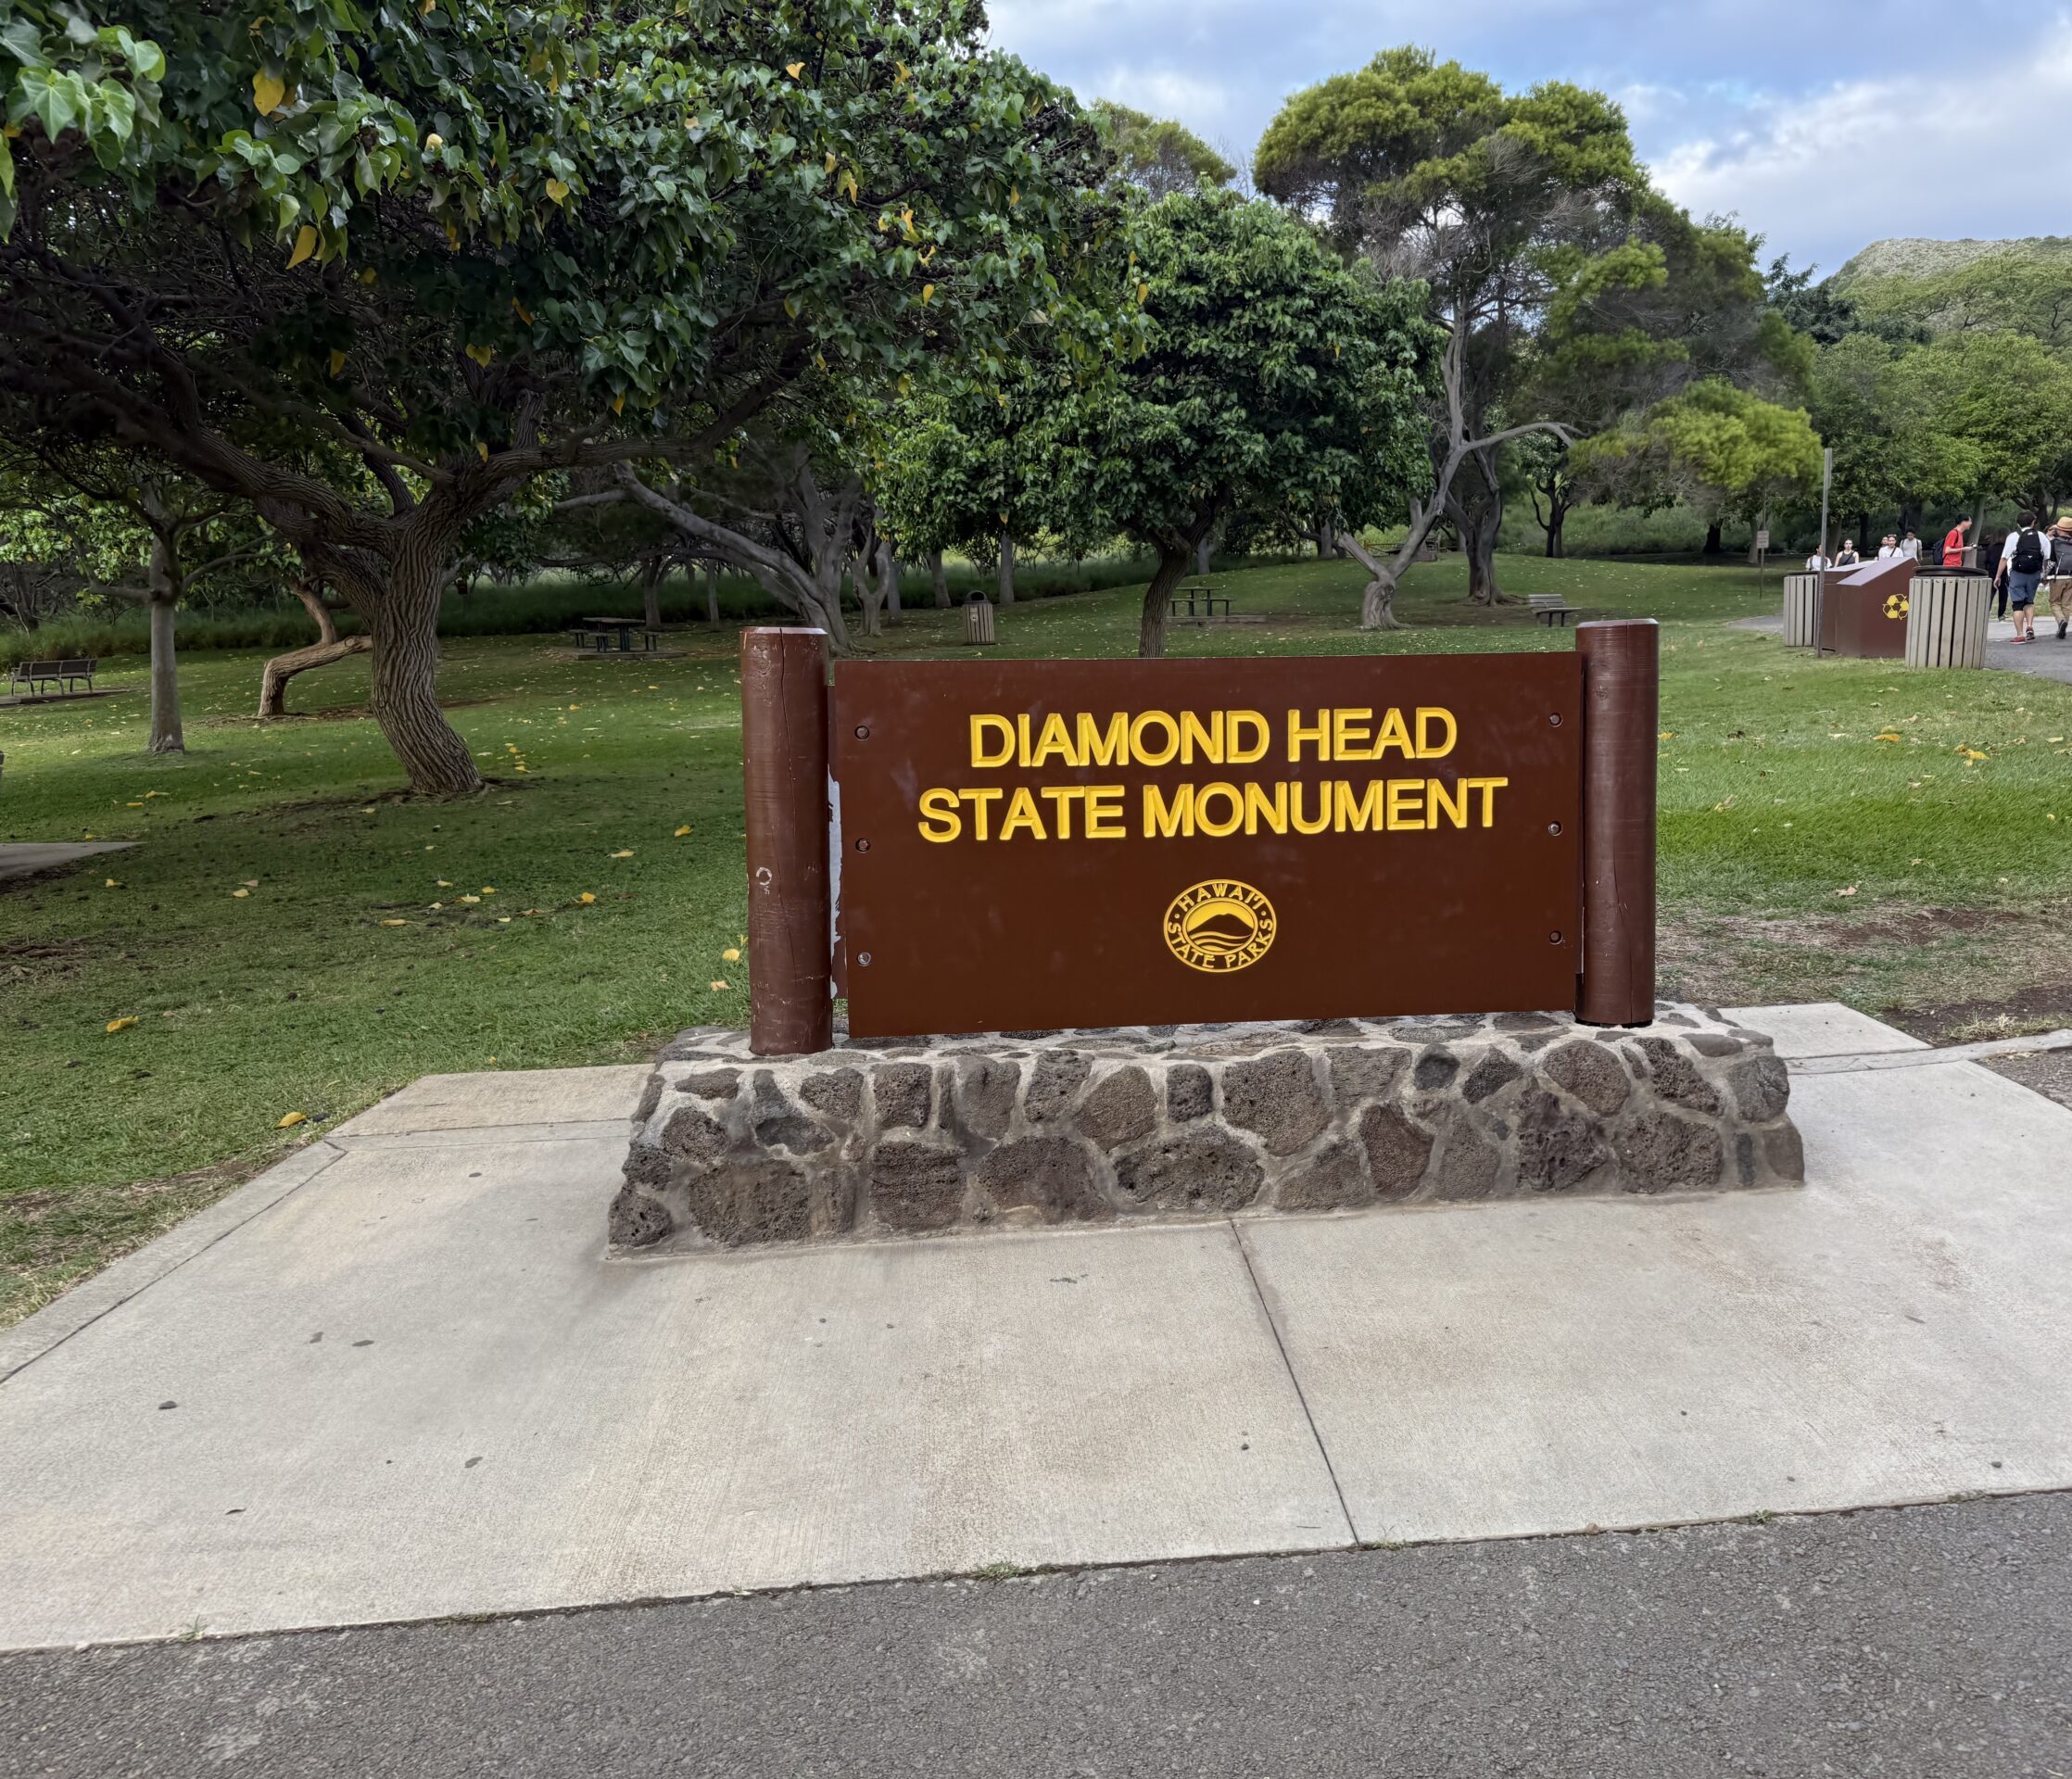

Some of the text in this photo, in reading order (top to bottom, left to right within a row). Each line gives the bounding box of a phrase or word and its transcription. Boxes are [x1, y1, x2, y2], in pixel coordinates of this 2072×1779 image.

[969, 707, 1457, 767] DIAMOND HEAD
[918, 777, 1509, 843] STATE MONUMENT
[1168, 918, 1273, 968] STATE PARKS
